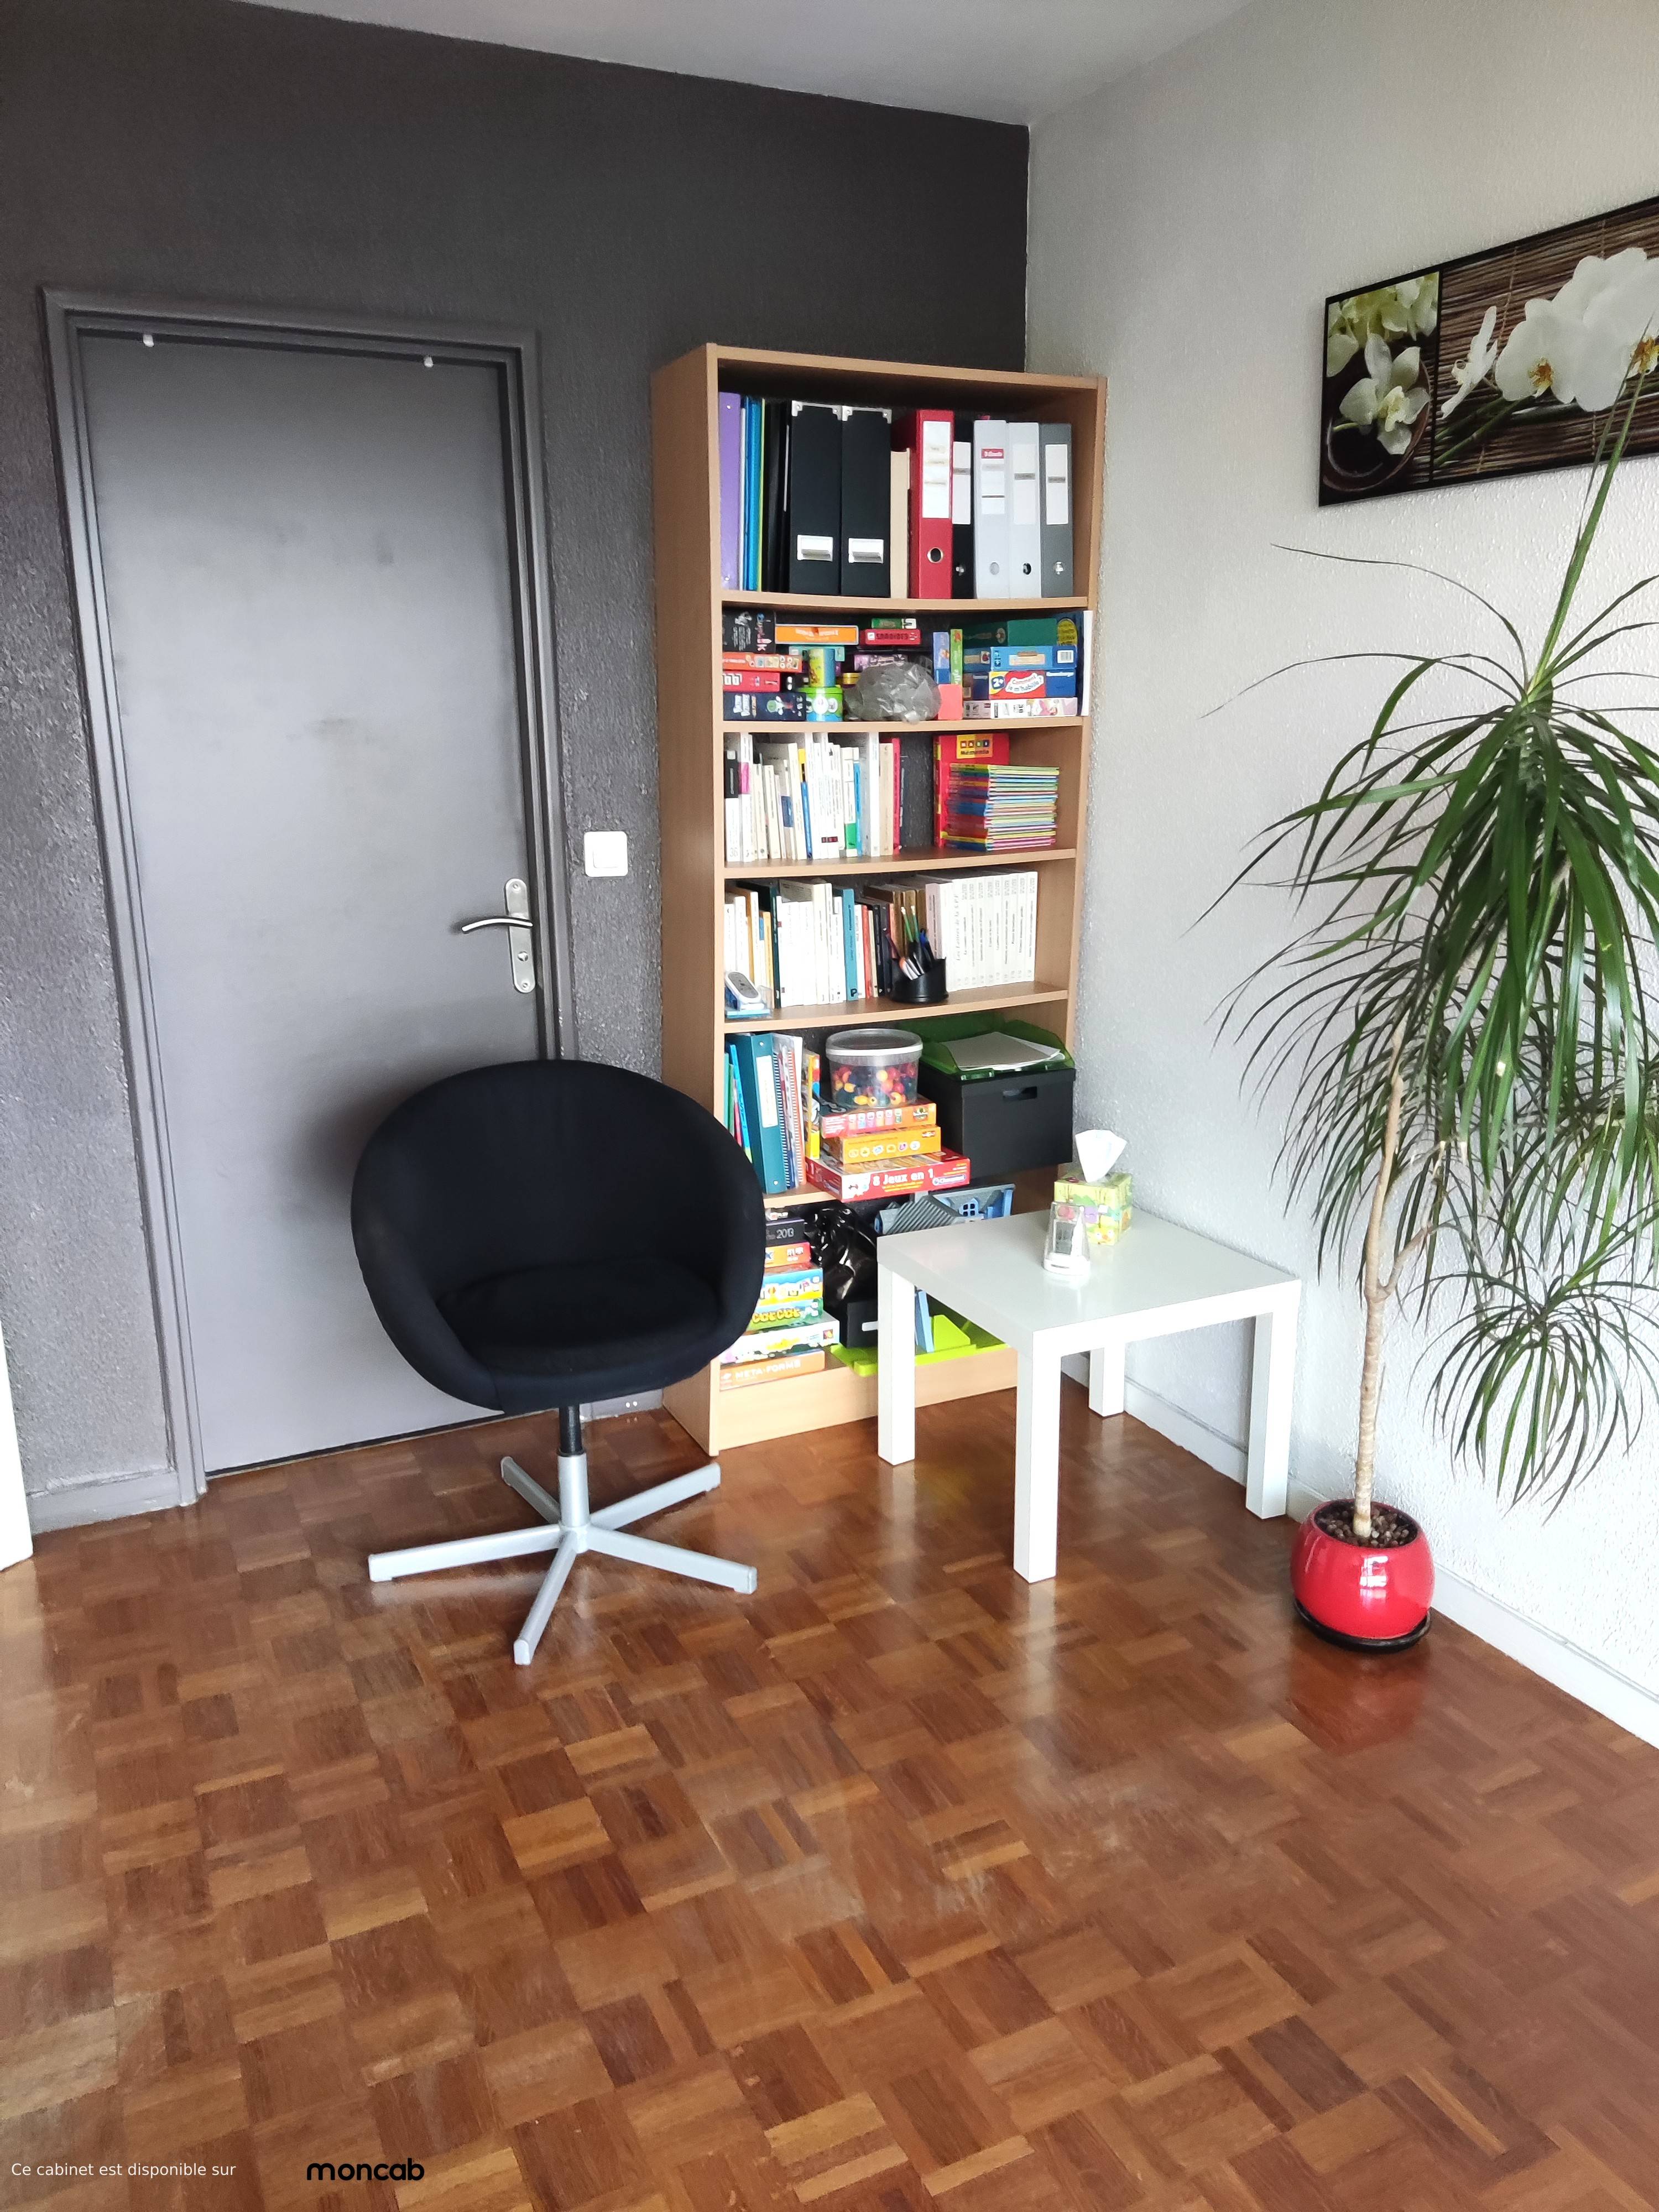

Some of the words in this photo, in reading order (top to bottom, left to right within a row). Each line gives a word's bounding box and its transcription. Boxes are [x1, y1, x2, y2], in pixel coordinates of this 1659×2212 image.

[872, 1175, 880, 1186] 8
[883, 1173, 908, 1185] Jeux
[910, 1171, 925, 1181] en
[928, 1168, 933, 1178] 1
